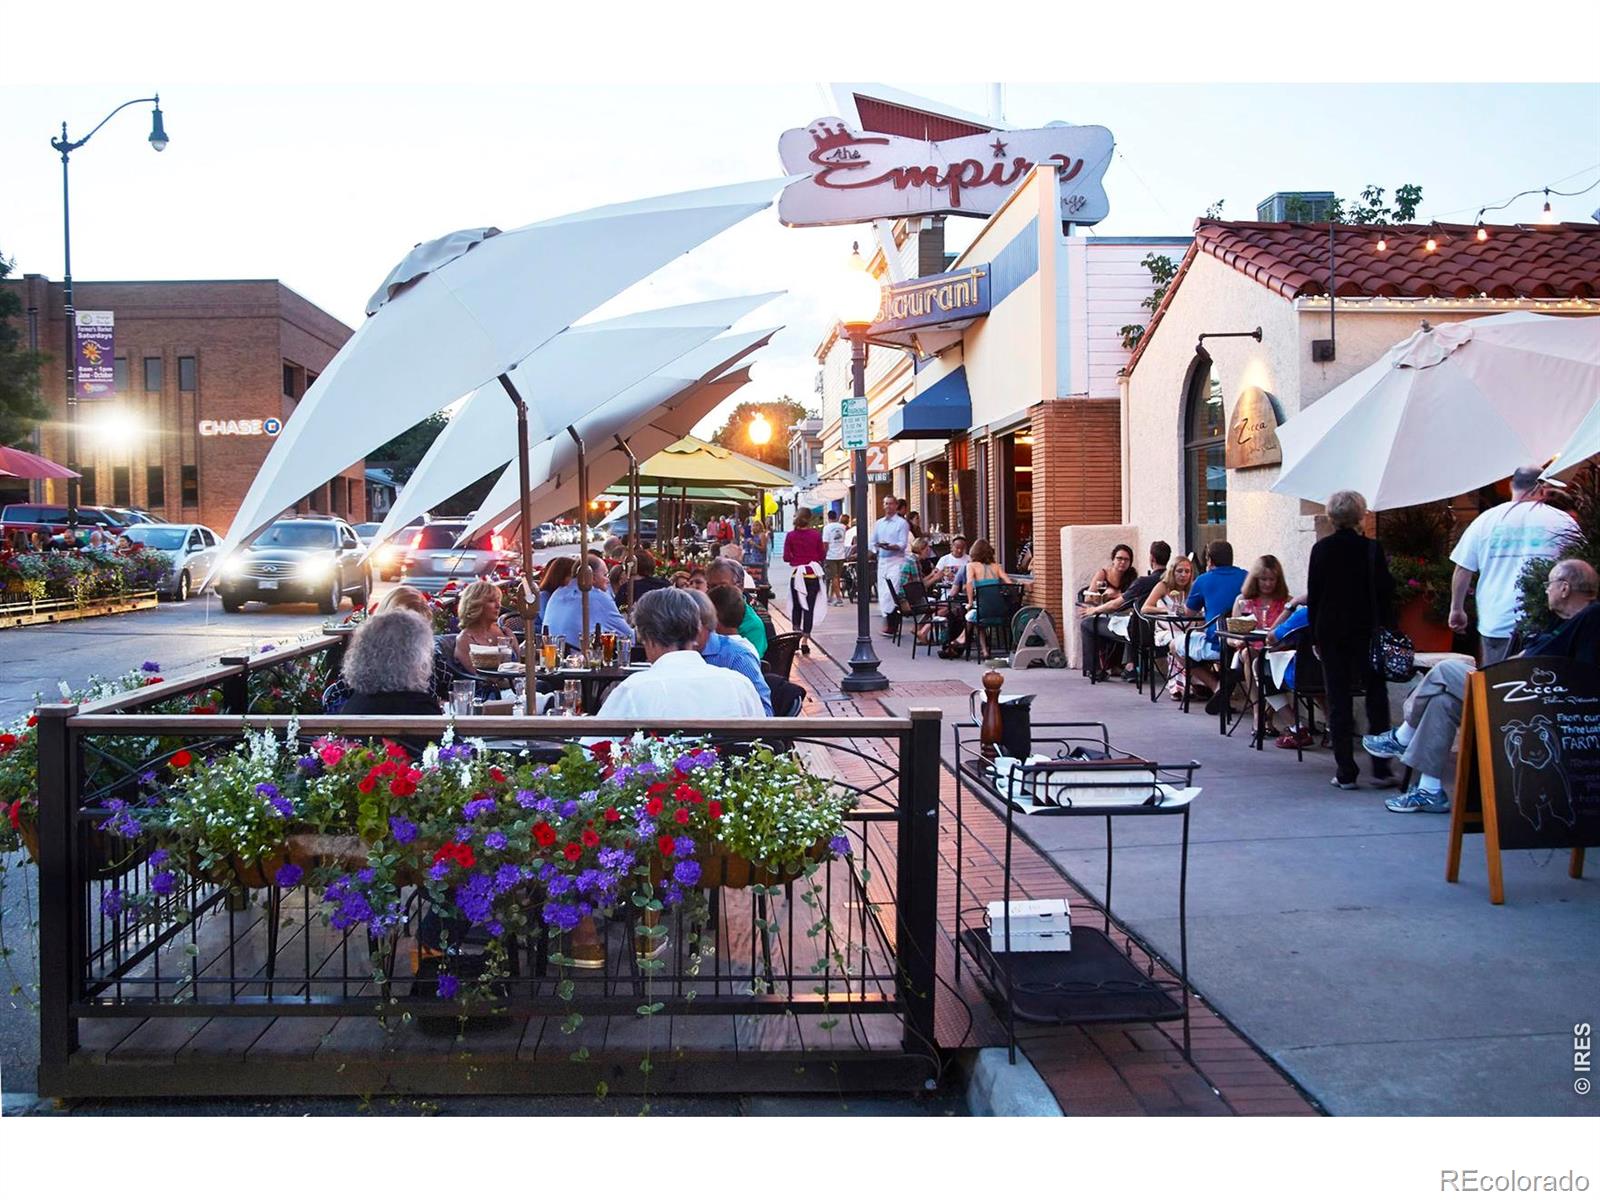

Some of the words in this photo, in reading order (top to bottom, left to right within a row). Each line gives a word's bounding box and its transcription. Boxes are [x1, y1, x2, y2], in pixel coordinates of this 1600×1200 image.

[826, 147, 861, 160] the
[808, 137, 1084, 208] Empire
[875, 266, 987, 322] staurant
[78, 332, 113, 340] Saturdays
[843, 402, 848, 415] 2
[199, 420, 263, 436] CHASE
[867, 473, 887, 481] WING
[1492, 681, 1568, 702] Zucca
[1561, 735, 1600, 750] FARM
